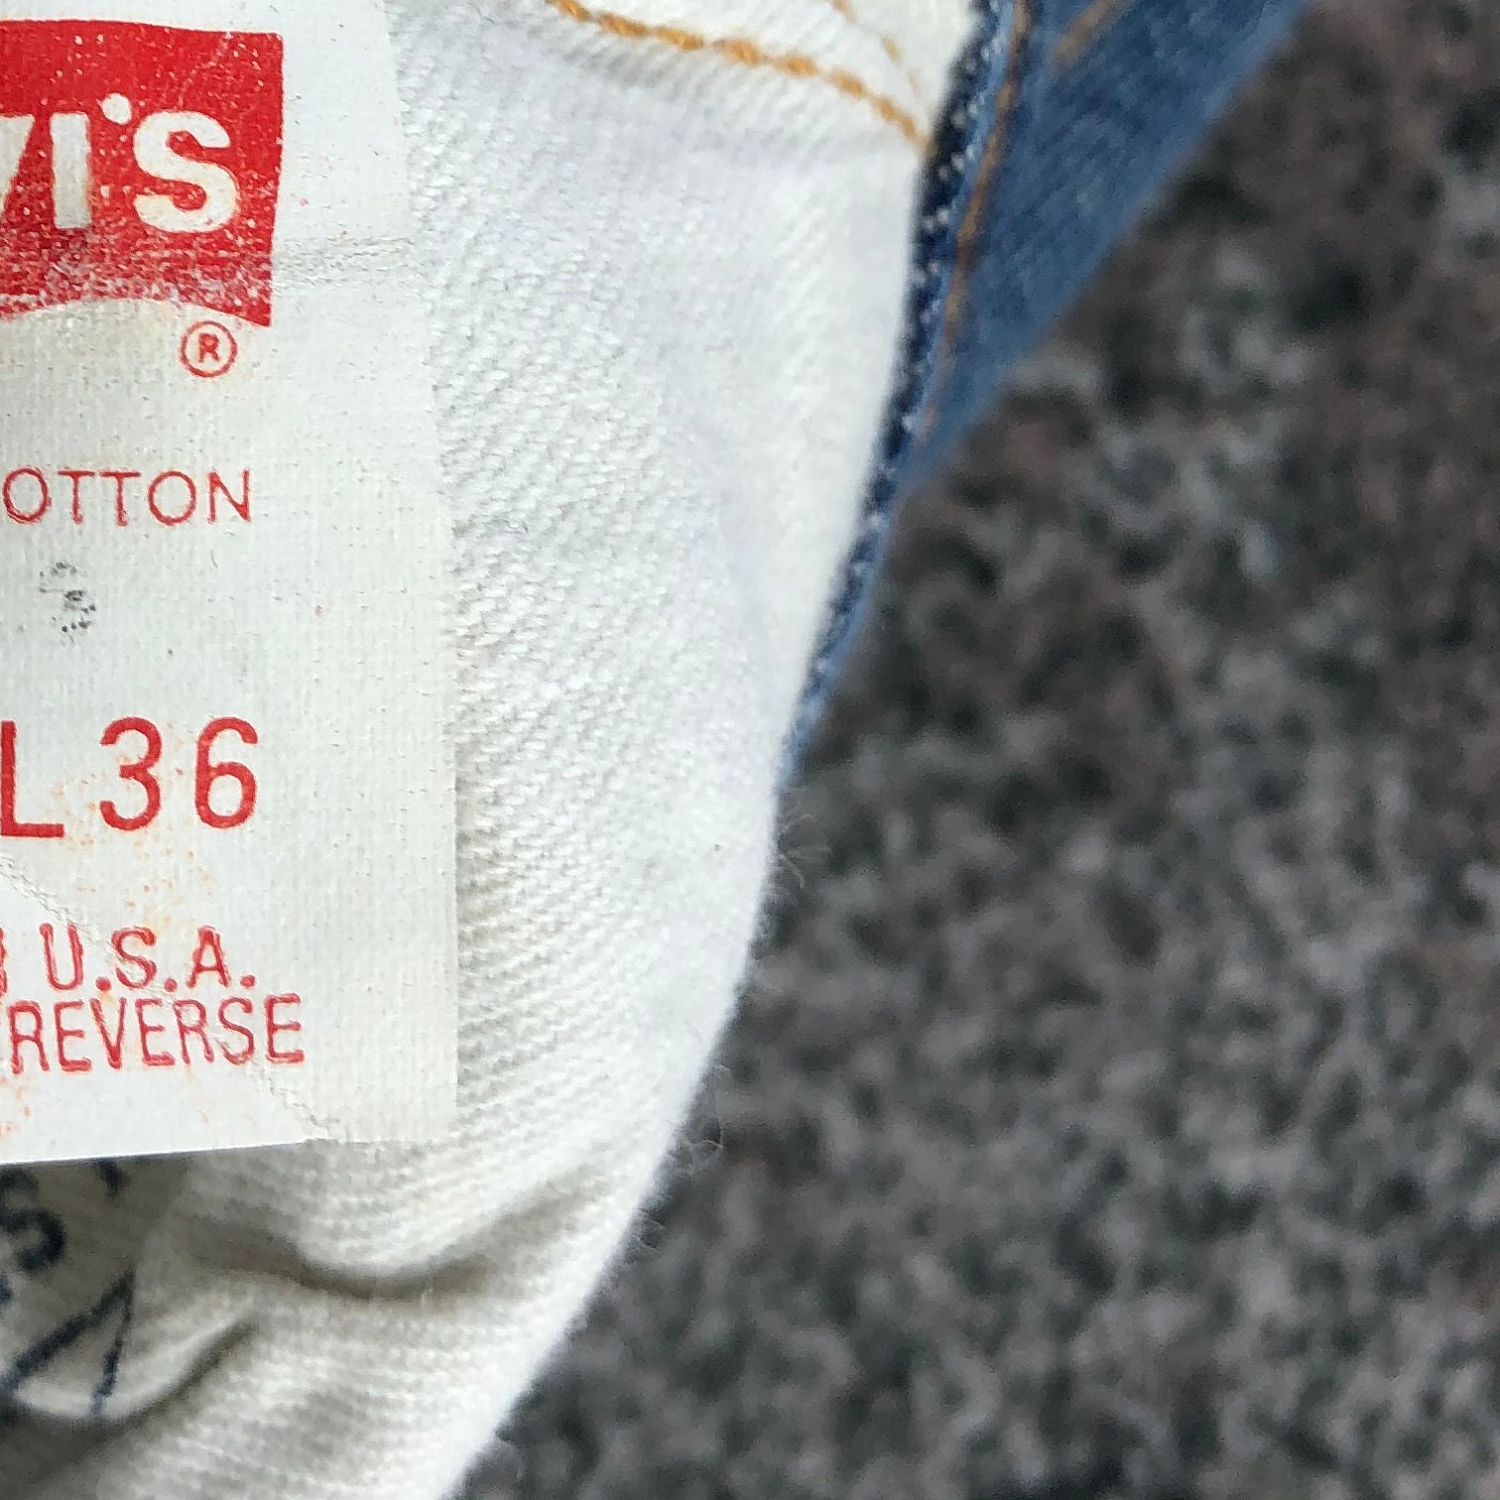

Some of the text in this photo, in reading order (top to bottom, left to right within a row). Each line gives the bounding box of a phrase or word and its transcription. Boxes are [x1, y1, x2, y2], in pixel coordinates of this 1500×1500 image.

[0, 715, 260, 839] L36
[38, 923, 258, 992] U.S.A.
[7, 992, 306, 1076] REVERSE
